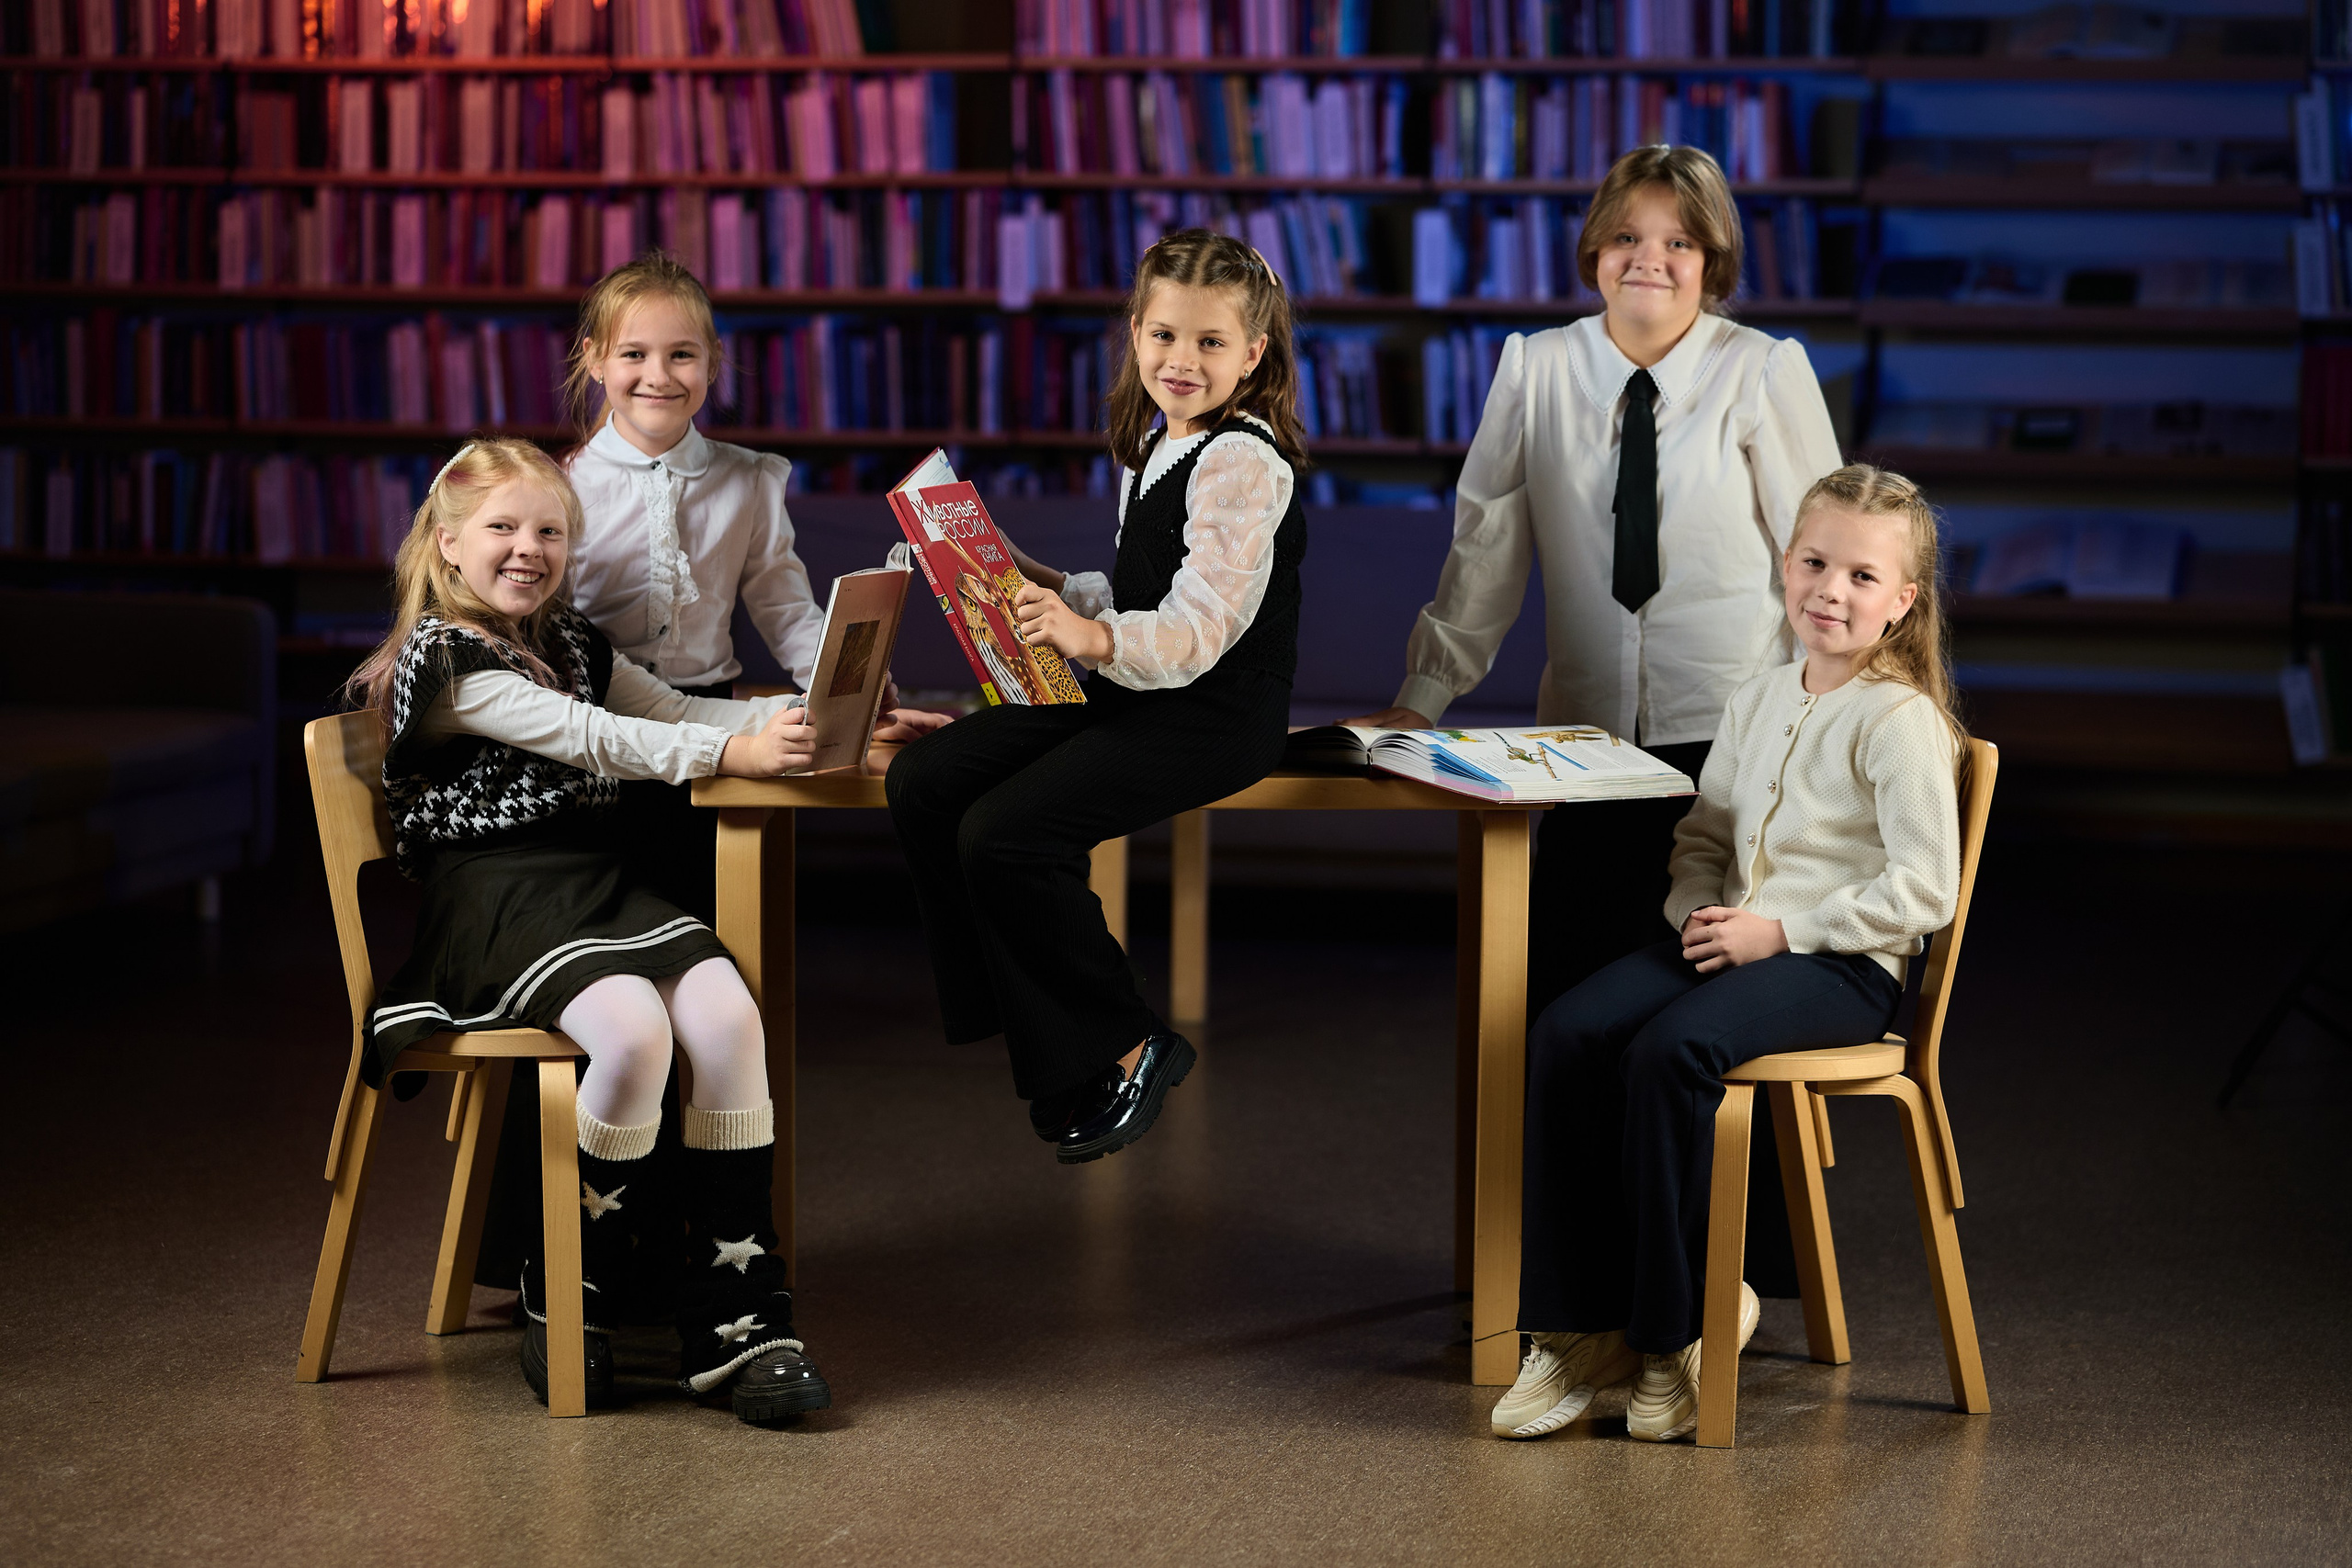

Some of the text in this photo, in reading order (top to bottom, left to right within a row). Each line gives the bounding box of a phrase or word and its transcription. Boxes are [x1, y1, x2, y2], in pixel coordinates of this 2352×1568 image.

[938, 517, 990, 540] РОССИИ
[975, 544, 999, 553] КРАСНАЯ
[981, 551, 1005, 563] КНИГА
